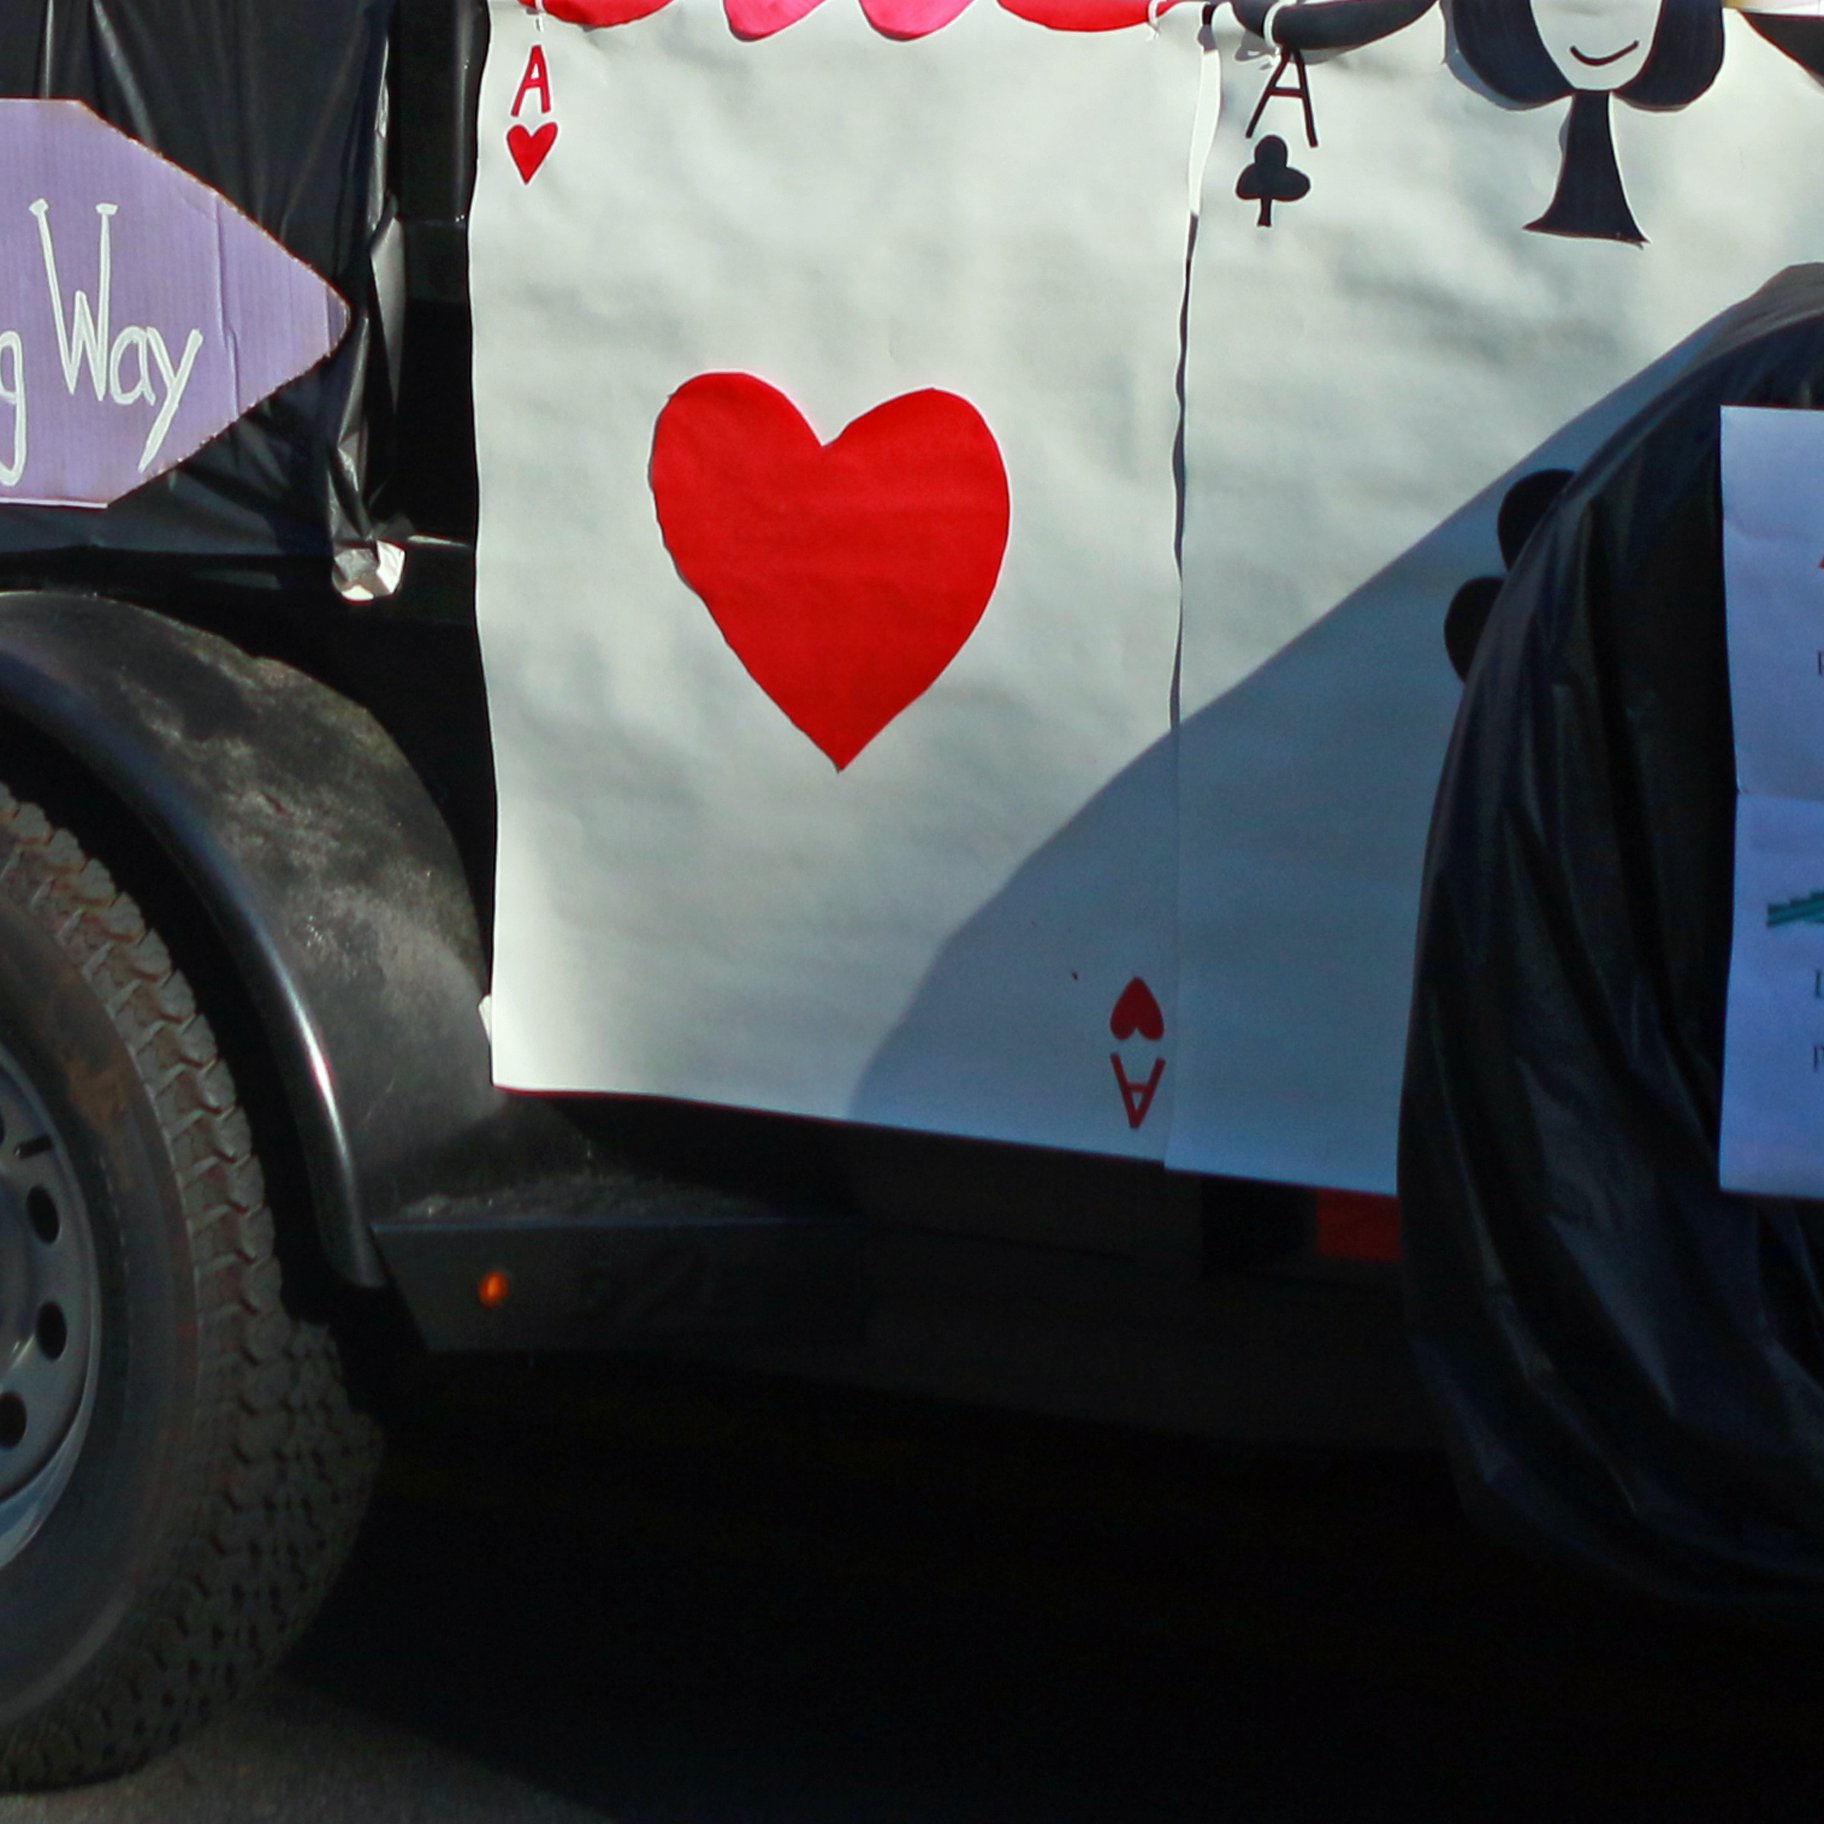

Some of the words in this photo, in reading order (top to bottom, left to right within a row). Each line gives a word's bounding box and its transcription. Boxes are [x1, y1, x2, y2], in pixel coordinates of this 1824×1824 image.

[510, 43, 552, 118] A
[1245, 46, 1318, 148] A
[29, 197, 203, 474] Way
